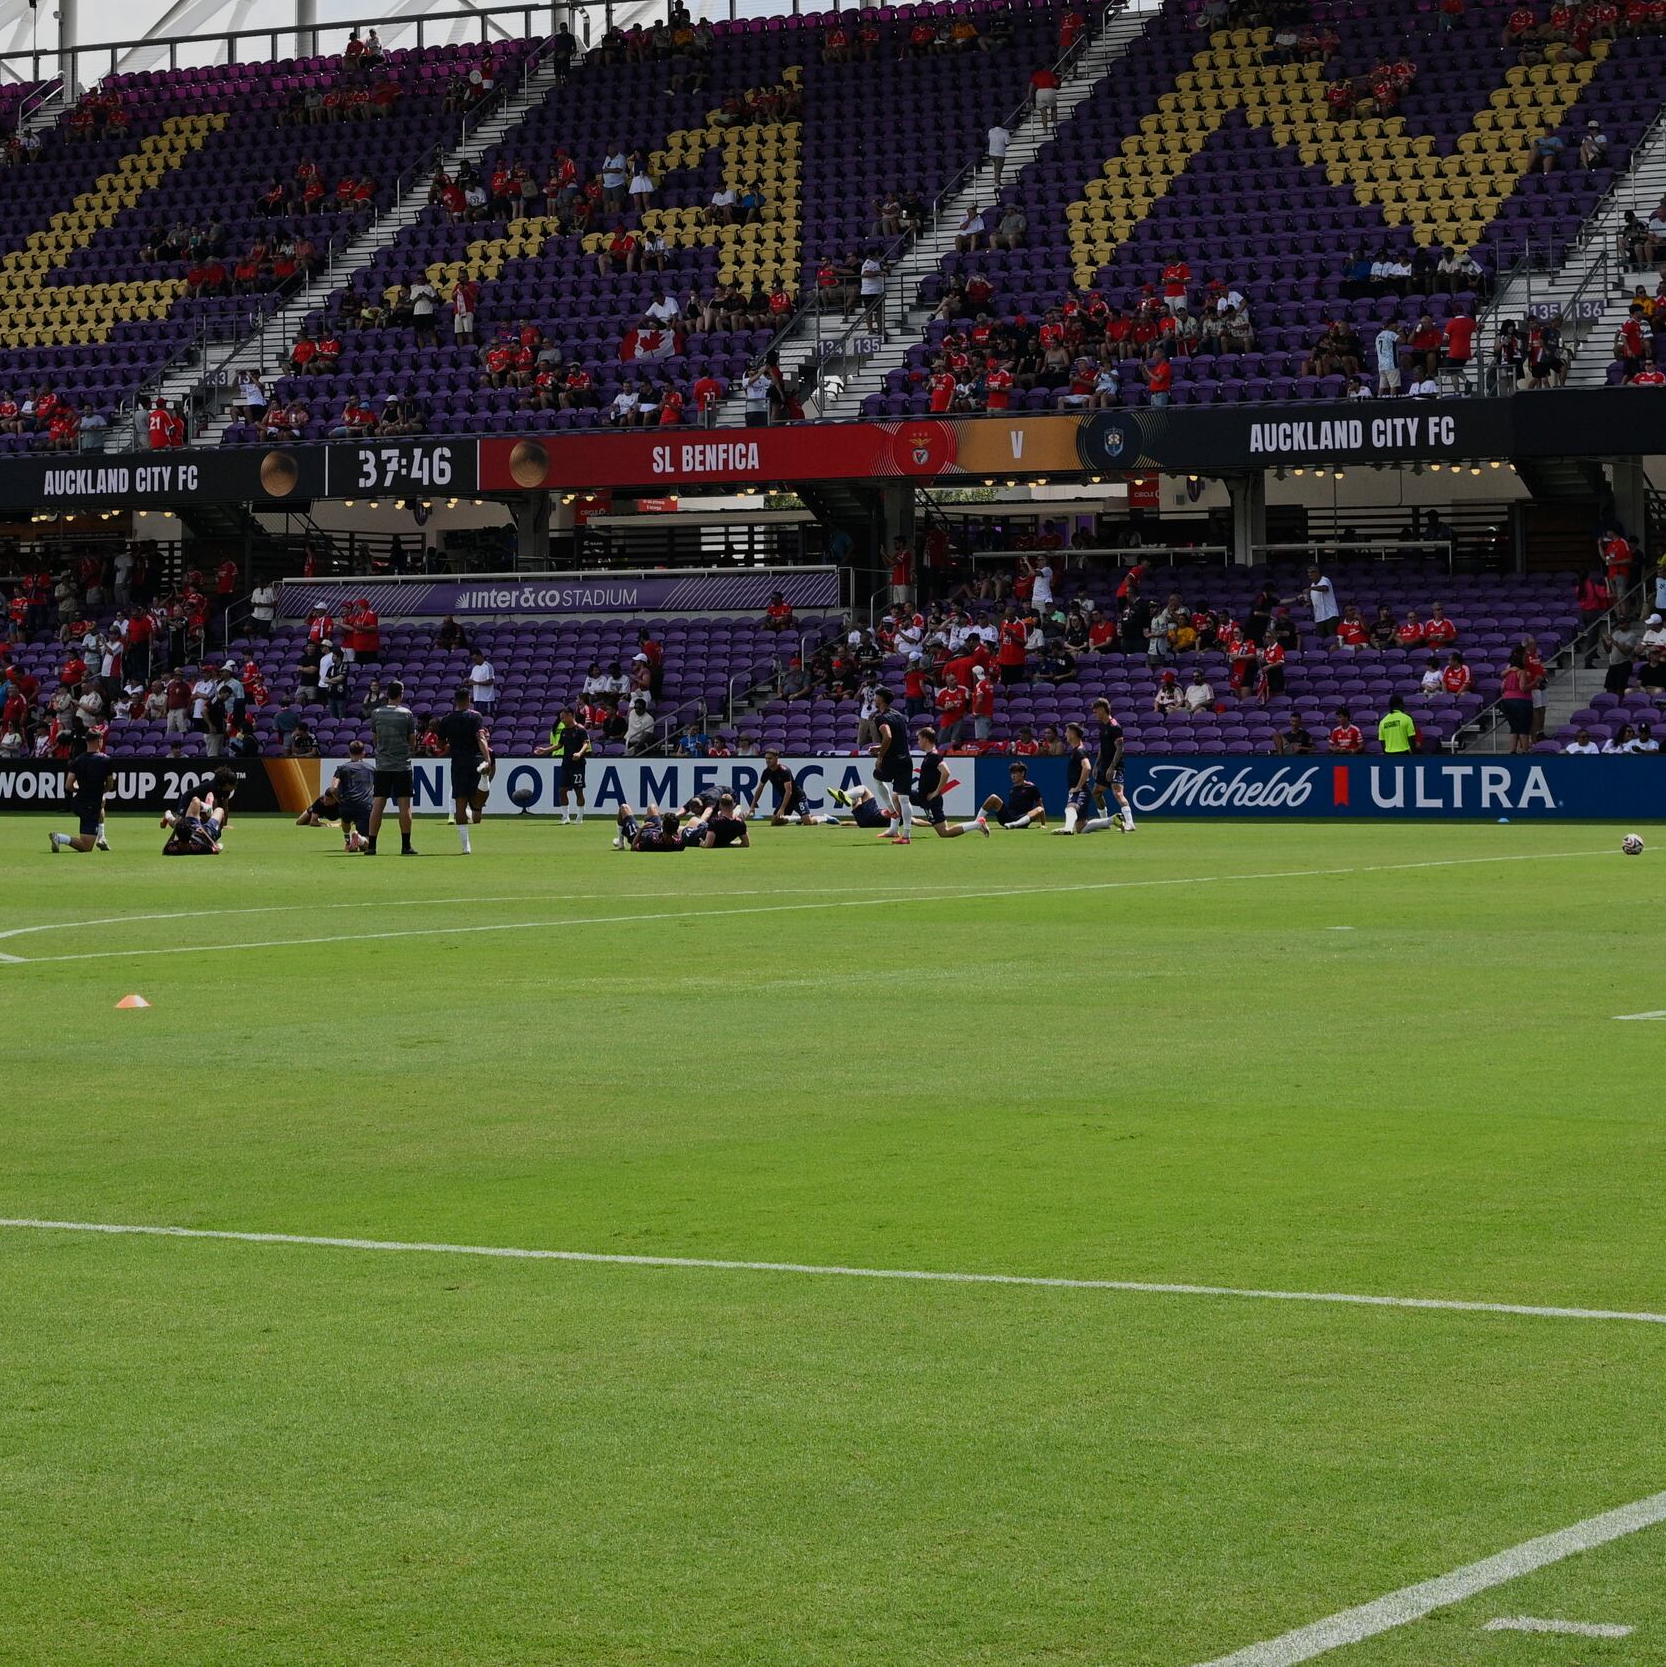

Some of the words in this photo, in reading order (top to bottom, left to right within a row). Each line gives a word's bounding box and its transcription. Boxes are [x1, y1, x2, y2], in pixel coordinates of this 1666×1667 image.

[1531, 304, 1558, 320] 135
[1575, 303, 1604, 318] 136
[855, 338, 880, 354] 135
[150, 416, 161, 430] 21
[1010, 431, 1024, 459] V
[1250, 420, 1363, 453] AUCKLAND
[1372, 417, 1419, 449] CITY
[1429, 415, 1456, 446] FC
[358, 446, 453, 488] 37:46
[653, 445, 675, 474] SL
[682, 441, 760, 472] BENFICA
[43, 469, 129, 496] AUCKLAND
[136, 466, 172, 492] CITY
[178, 464, 198, 490] FC
[562, 589, 638, 607] STADIUM
[573, 773, 583, 784] 22
[1132, 765, 1319, 812] Michelob
[1370, 765, 1558, 809] ULTRA
